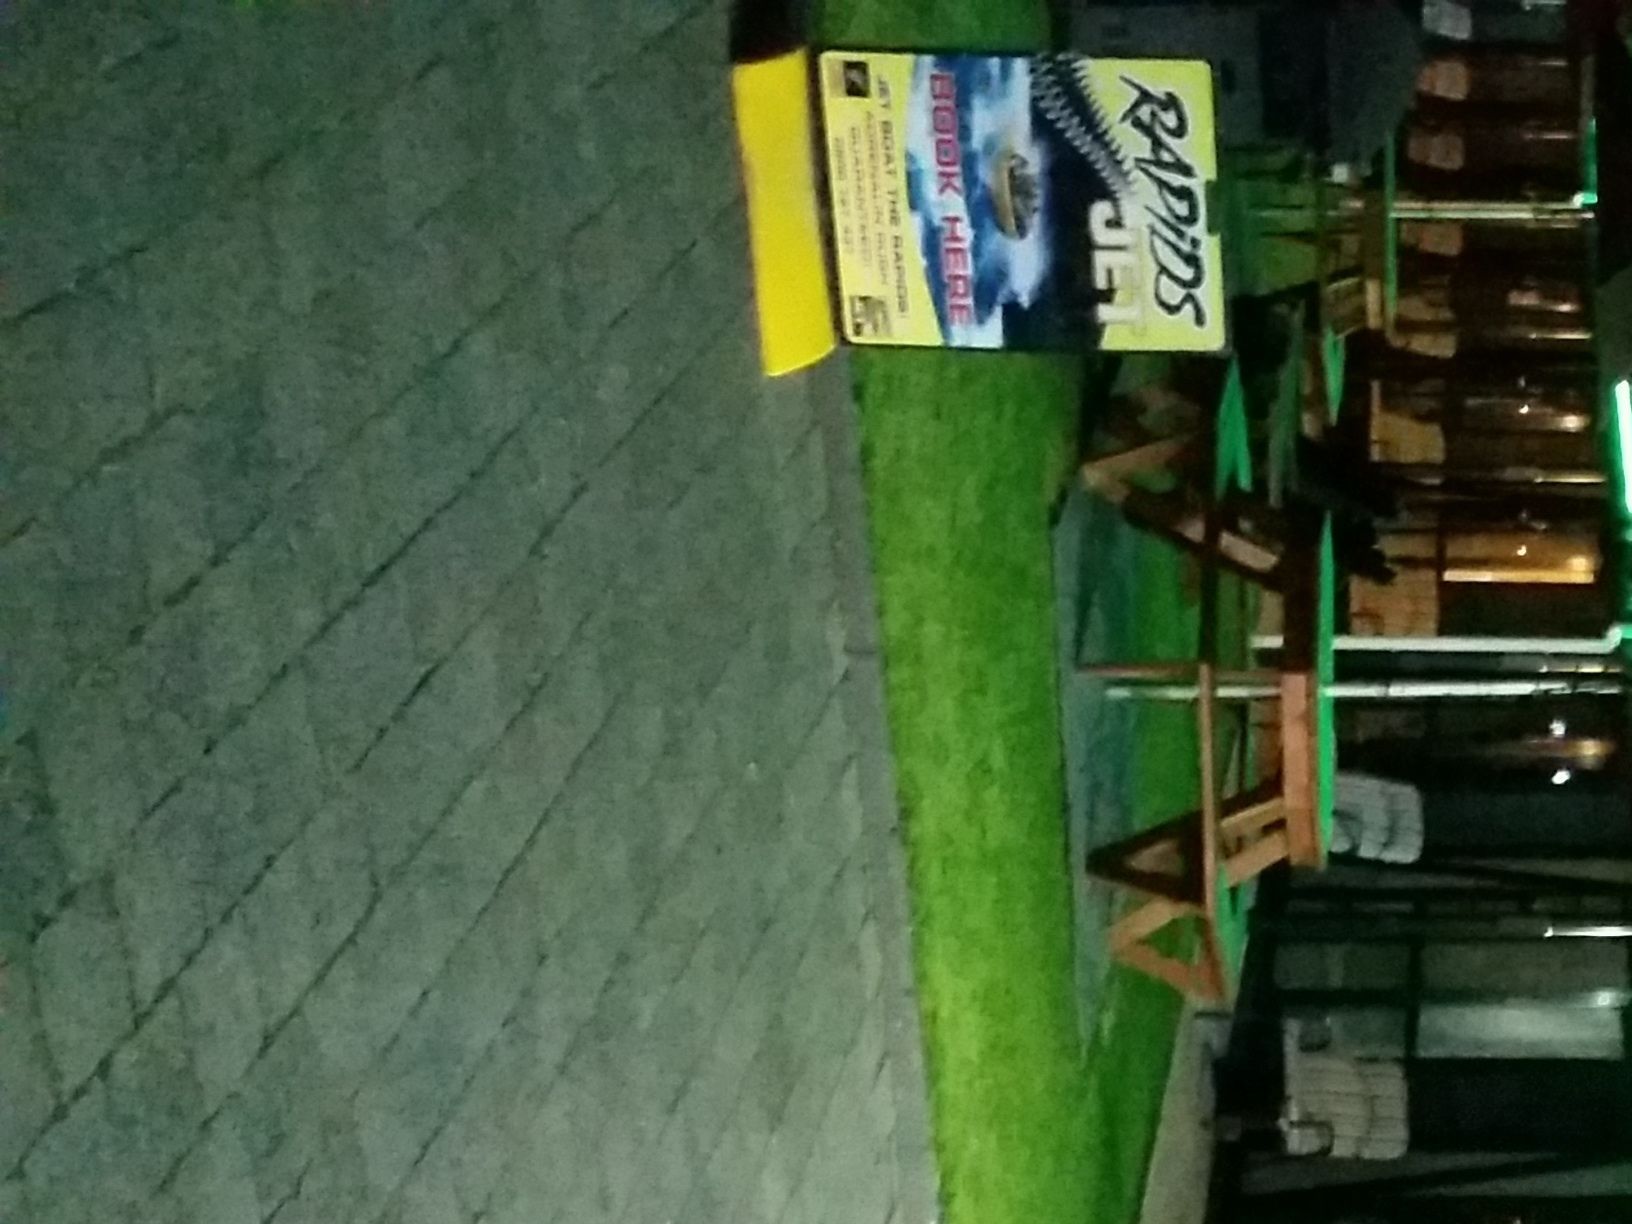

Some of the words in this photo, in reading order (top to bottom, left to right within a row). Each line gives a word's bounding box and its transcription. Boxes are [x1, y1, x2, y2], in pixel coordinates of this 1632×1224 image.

[878, 77, 893, 109] JET
[930, 73, 961, 195] BOOK
[881, 120, 897, 177] BOAT
[888, 189, 902, 226] THE
[941, 216, 974, 326] HERE
[1089, 200, 1144, 328] JET
